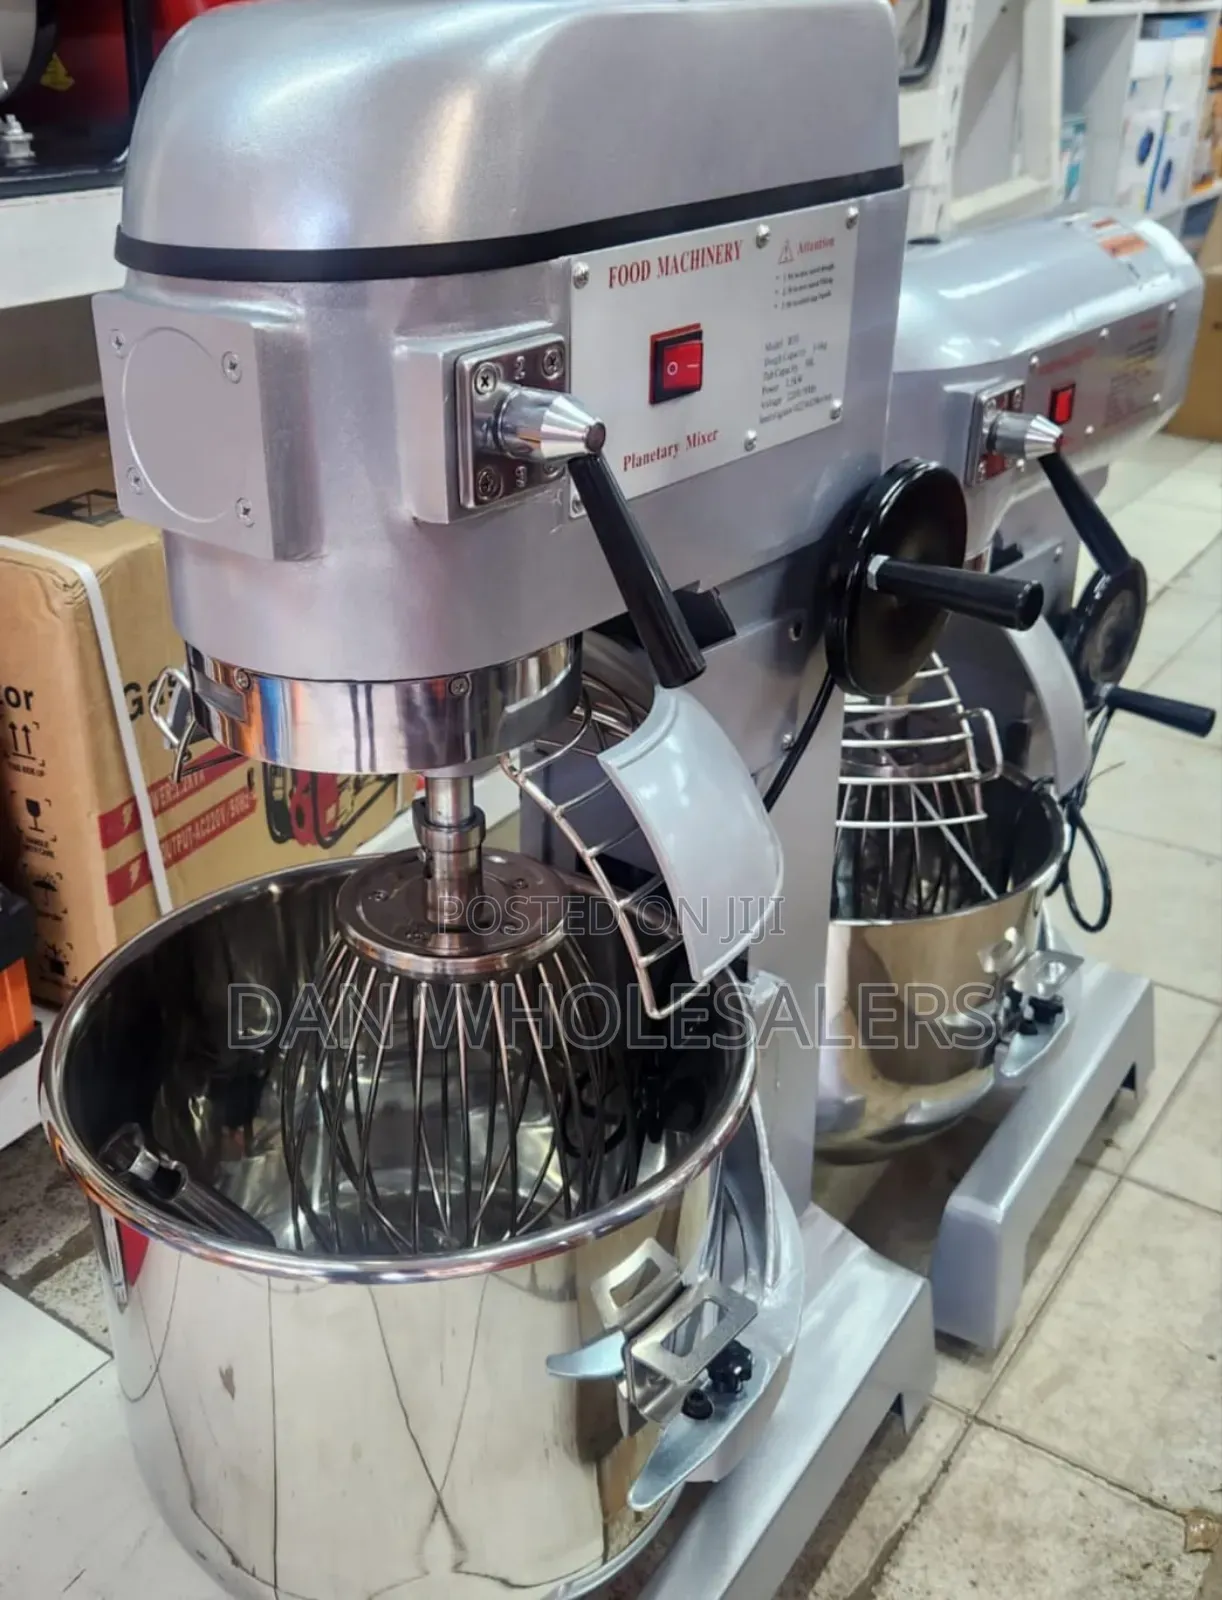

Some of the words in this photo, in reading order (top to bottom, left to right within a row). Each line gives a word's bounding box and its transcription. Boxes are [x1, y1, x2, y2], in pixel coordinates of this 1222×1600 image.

[797, 236, 835, 255] Attention
[608, 259, 651, 289] FOOD
[656, 239, 744, 279] MACHINERY
[623, 442, 680, 472] Planetary
[685, 429, 719, 451] Mixer
[0, 684, 34, 712] or
